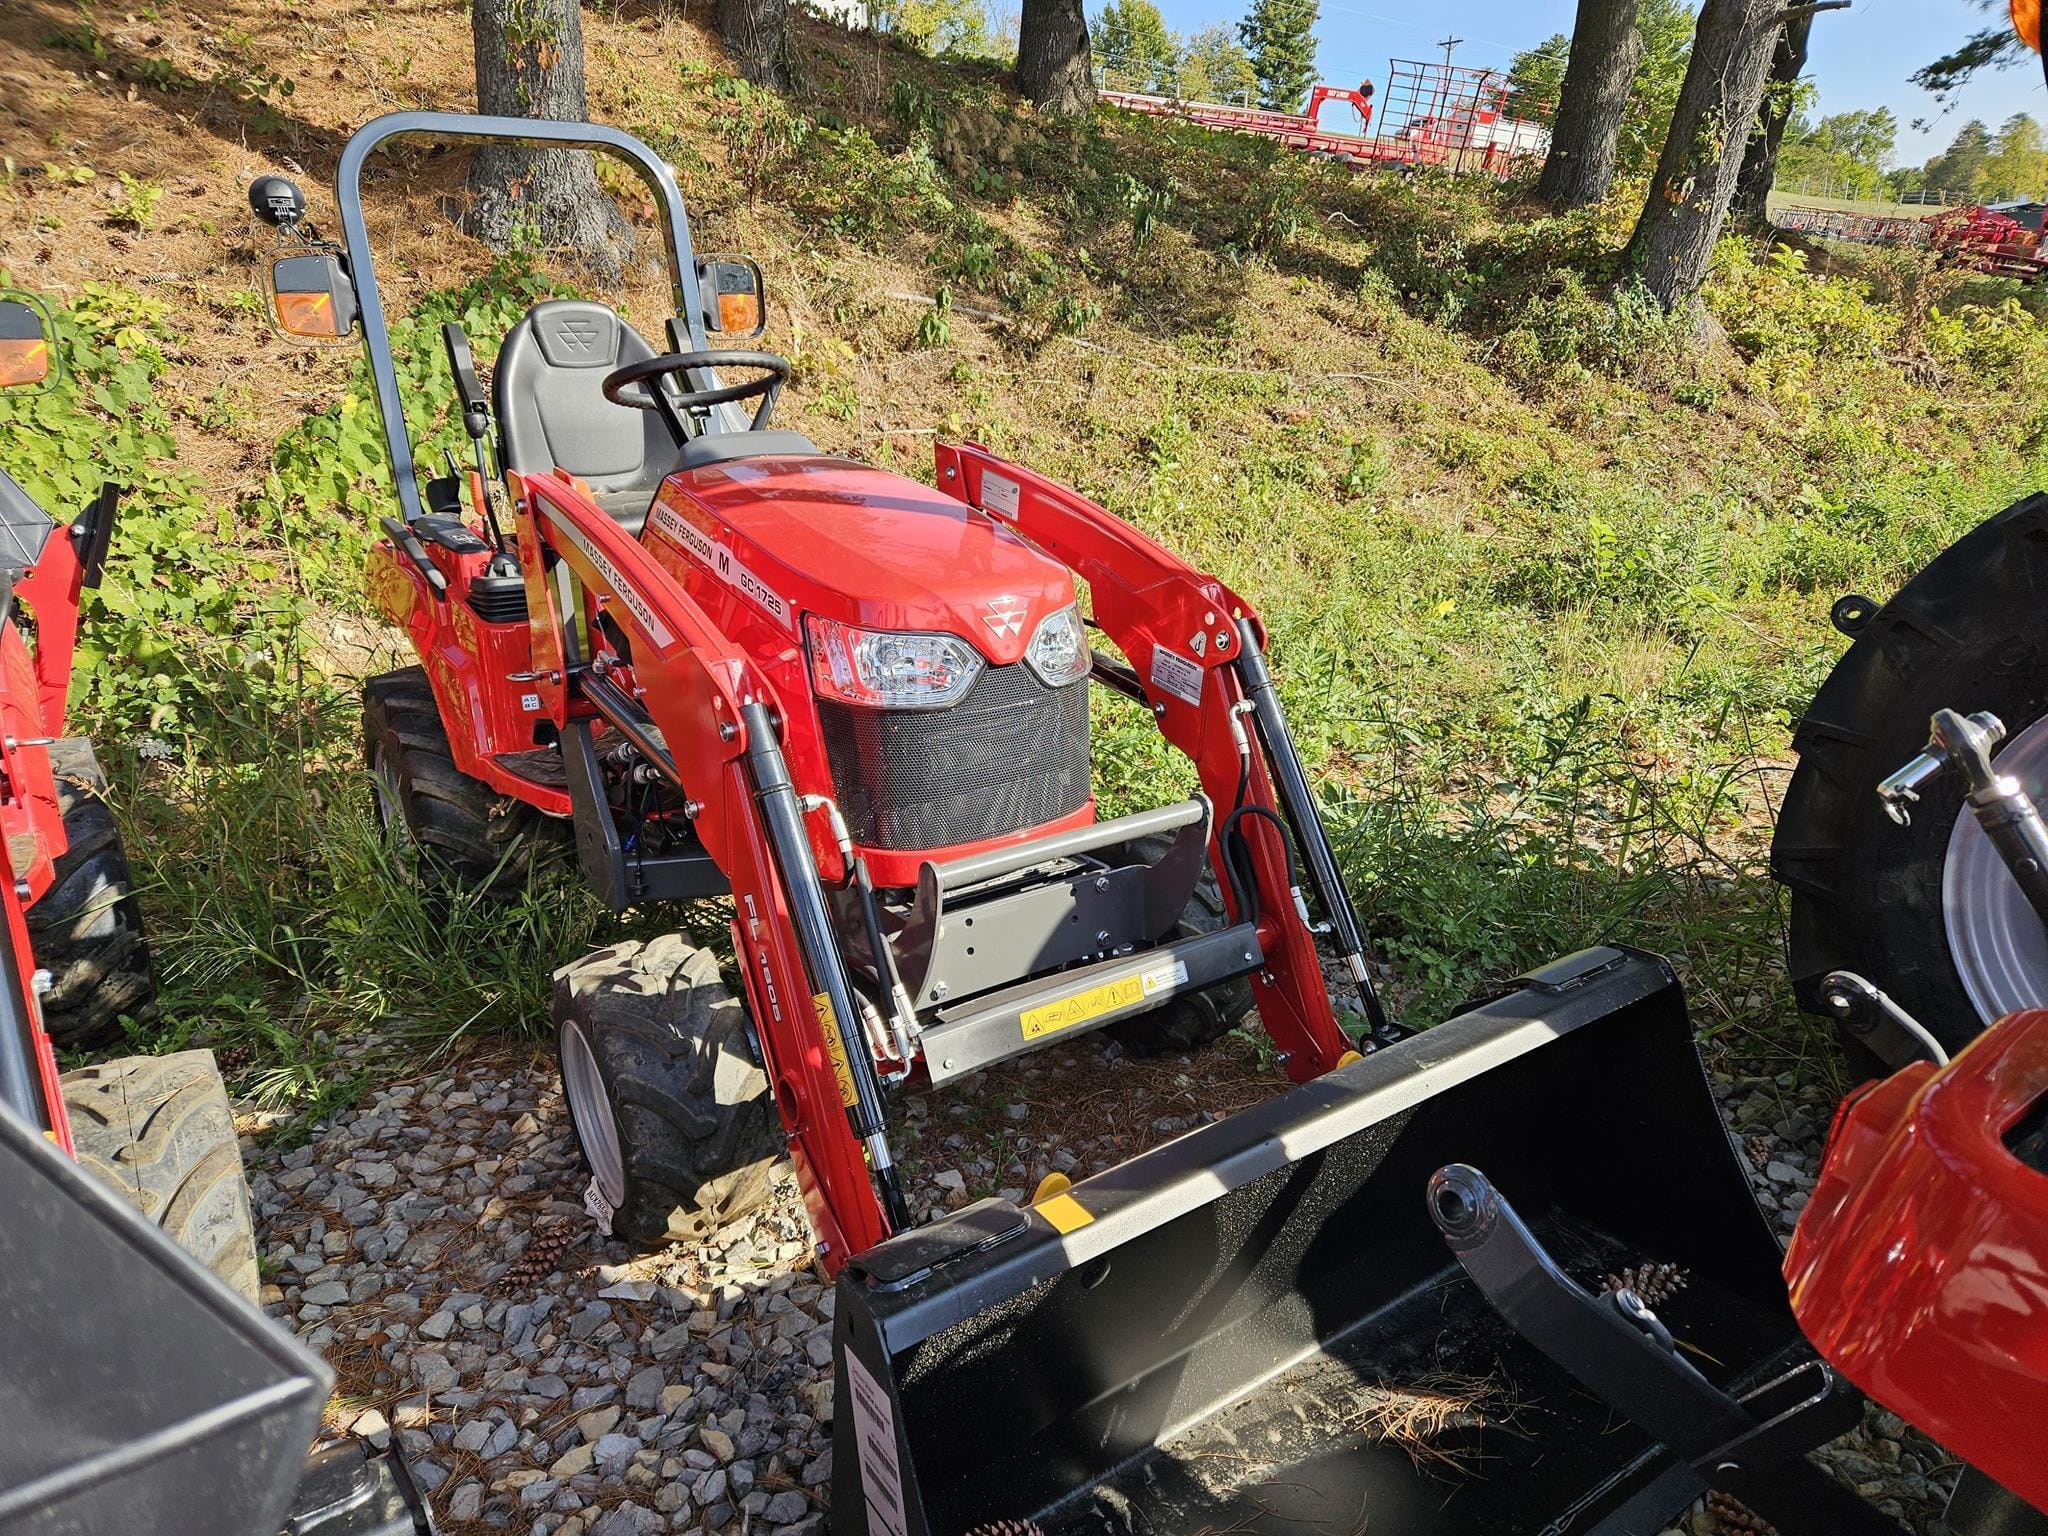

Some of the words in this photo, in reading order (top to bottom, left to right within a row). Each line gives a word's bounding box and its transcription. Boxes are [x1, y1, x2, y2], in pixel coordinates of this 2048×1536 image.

[583, 539, 612, 578] MASSEY
[613, 572, 655, 631] FERGUSON
[656, 507, 678, 532] MASSEY
[678, 524, 713, 560] FERGUSON
[719, 551, 730, 575] M
[741, 573, 754, 593] GC
[756, 586, 781, 615] 1725
[743, 893, 759, 941] FL
